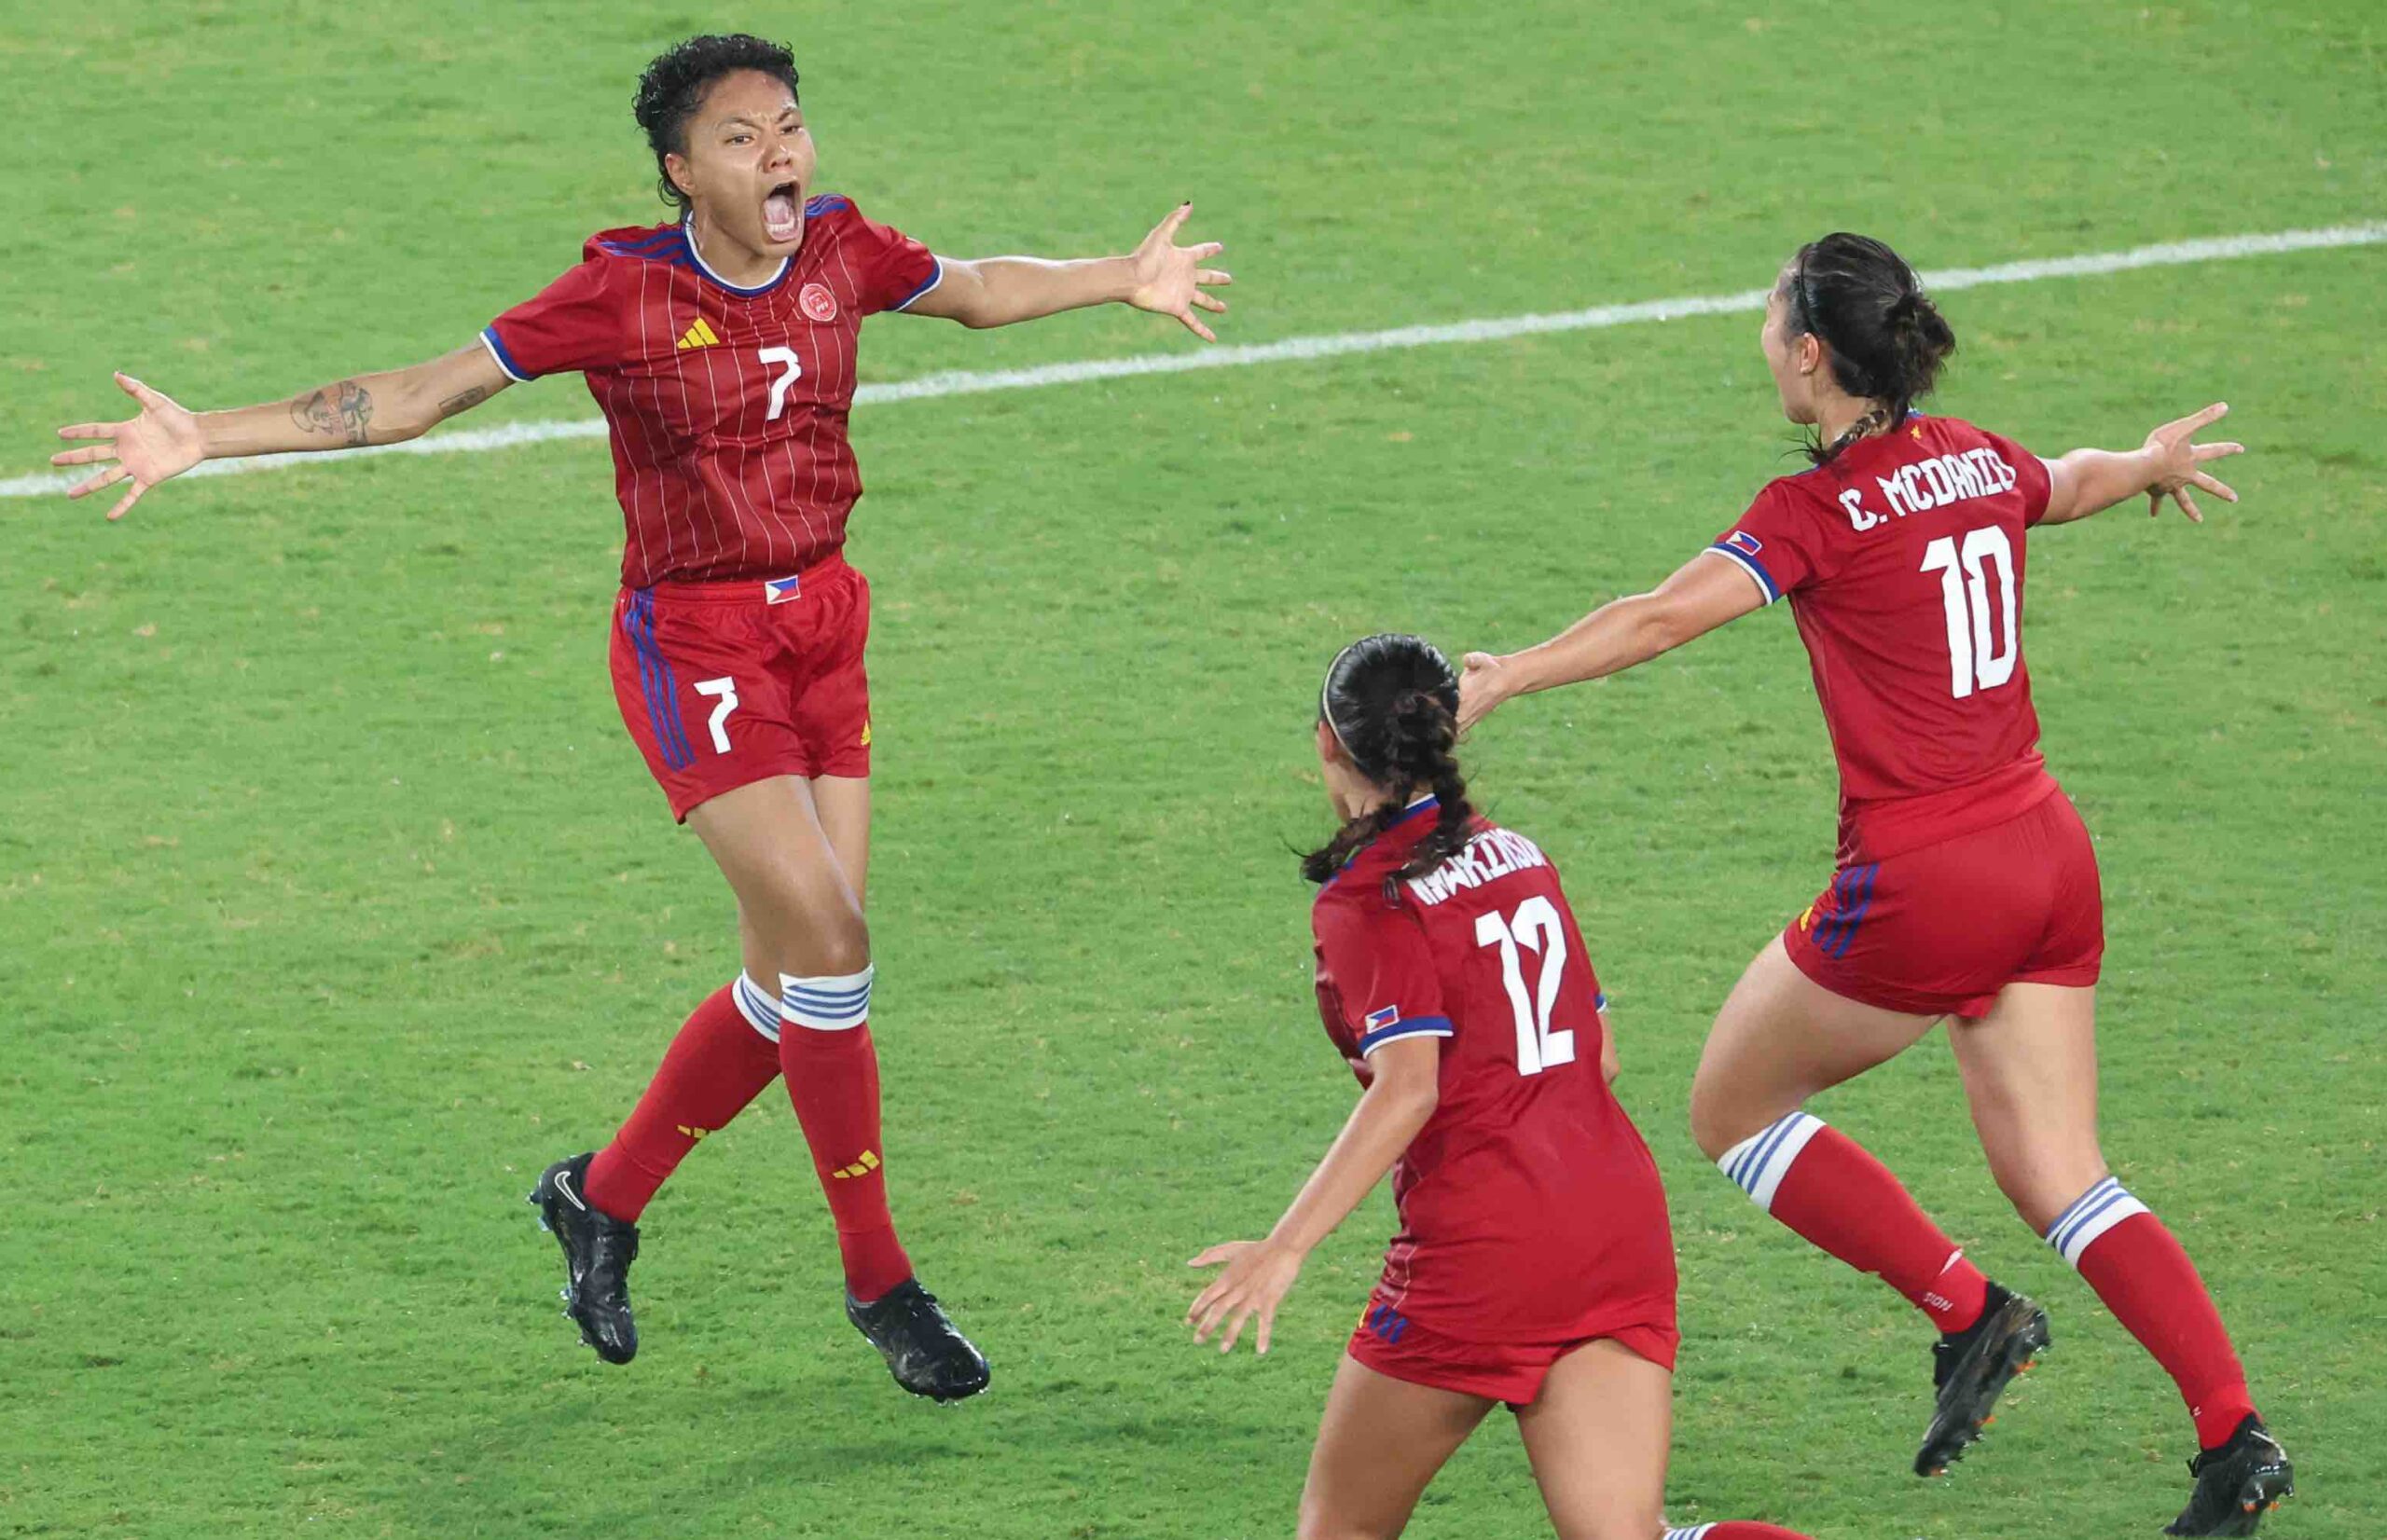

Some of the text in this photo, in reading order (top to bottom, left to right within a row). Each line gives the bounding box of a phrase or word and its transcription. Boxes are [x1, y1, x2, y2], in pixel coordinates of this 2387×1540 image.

[757, 346, 802, 420] 7
[1838, 488, 1889, 532] C.
[1919, 525, 2018, 699] 10
[693, 676, 738, 754] 7
[1474, 895, 1576, 1076] 12
